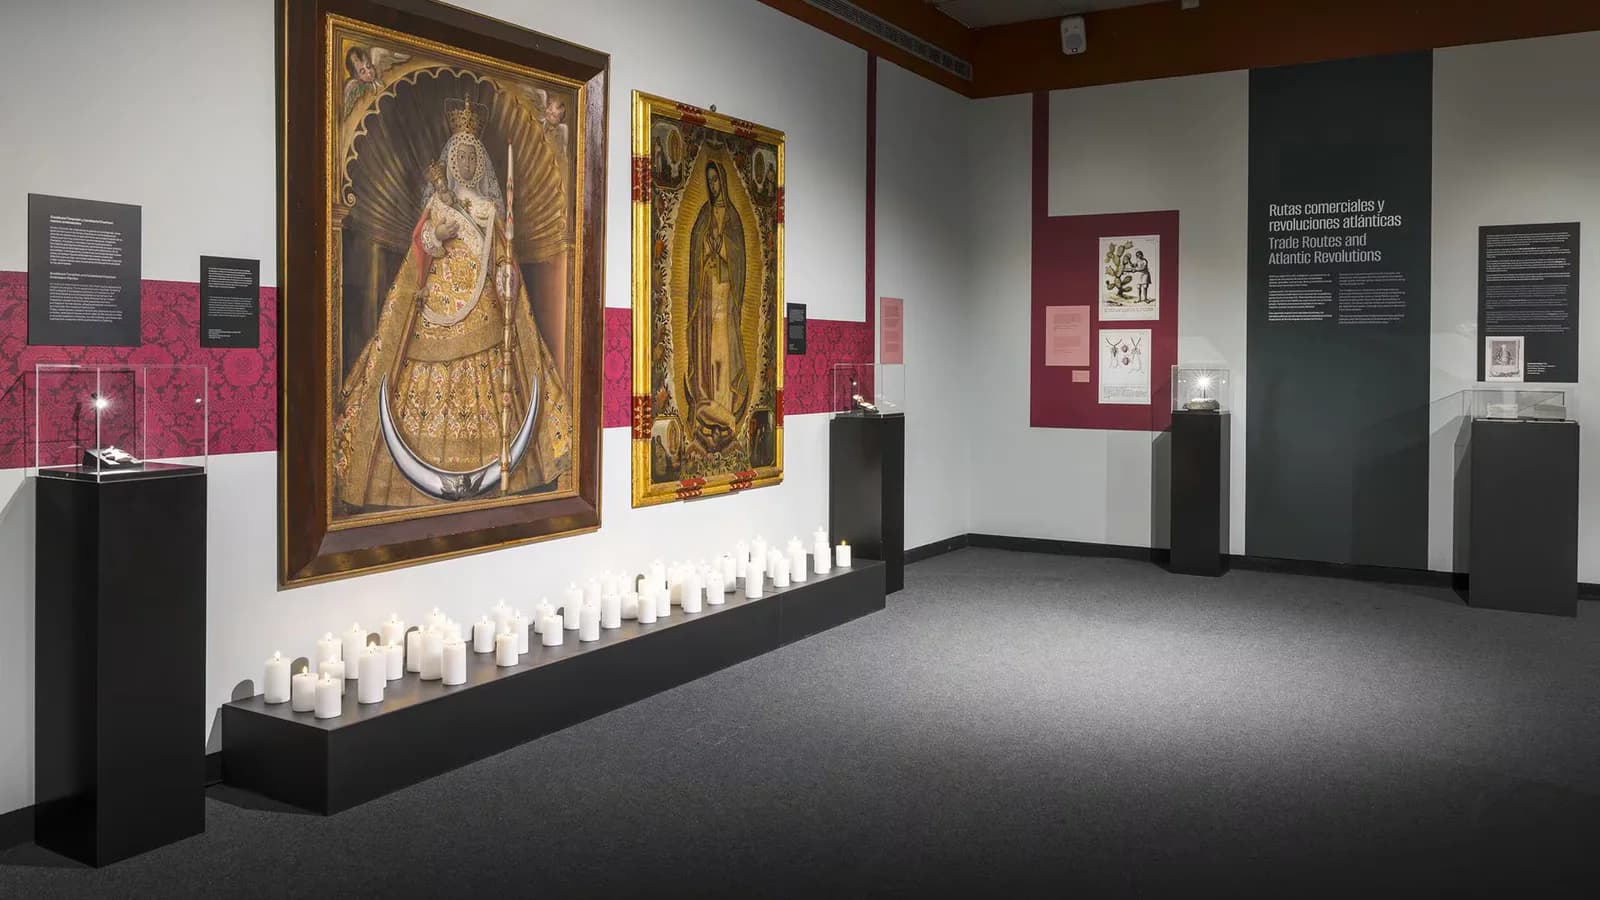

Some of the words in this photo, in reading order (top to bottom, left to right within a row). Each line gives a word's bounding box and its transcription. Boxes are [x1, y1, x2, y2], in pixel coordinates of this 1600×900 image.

[1269, 203, 1302, 217] Rutas
[1304, 199, 1375, 215] comerciales
[1377, 200, 1385, 214] y
[1269, 216, 1340, 232] revoluciones
[1343, 213, 1402, 229] atlánticas
[1268, 236, 1300, 250] Trade
[1302, 235, 1342, 249] Routes
[1345, 232, 1367, 247] and
[1268, 250, 1311, 265] Atlantic
[1314, 249, 1382, 264] Revolutions
